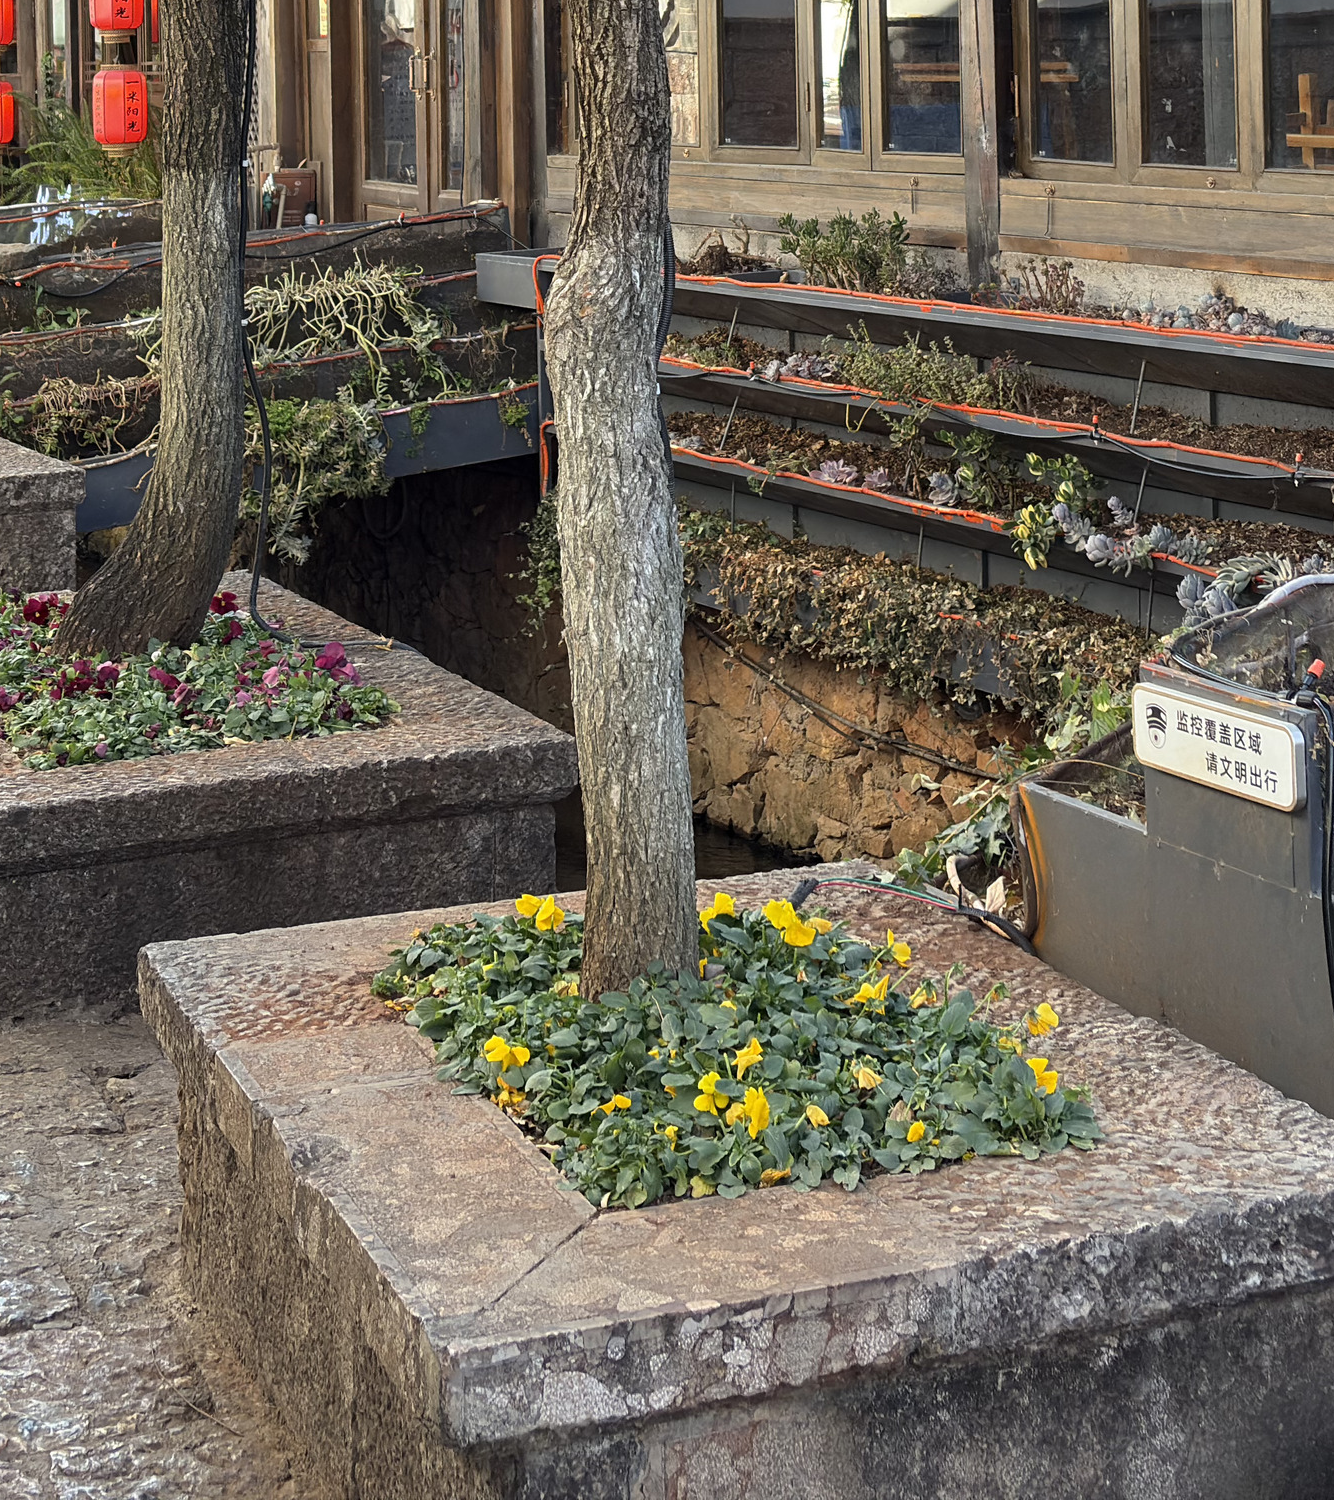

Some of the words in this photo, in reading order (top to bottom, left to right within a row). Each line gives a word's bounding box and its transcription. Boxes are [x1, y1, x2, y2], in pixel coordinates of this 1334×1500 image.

[126, 80, 140, 132] 一米阳光
[1176, 709, 1263, 756] 监控覆盖区域
[1205, 750, 1279, 794] 请文明出行
